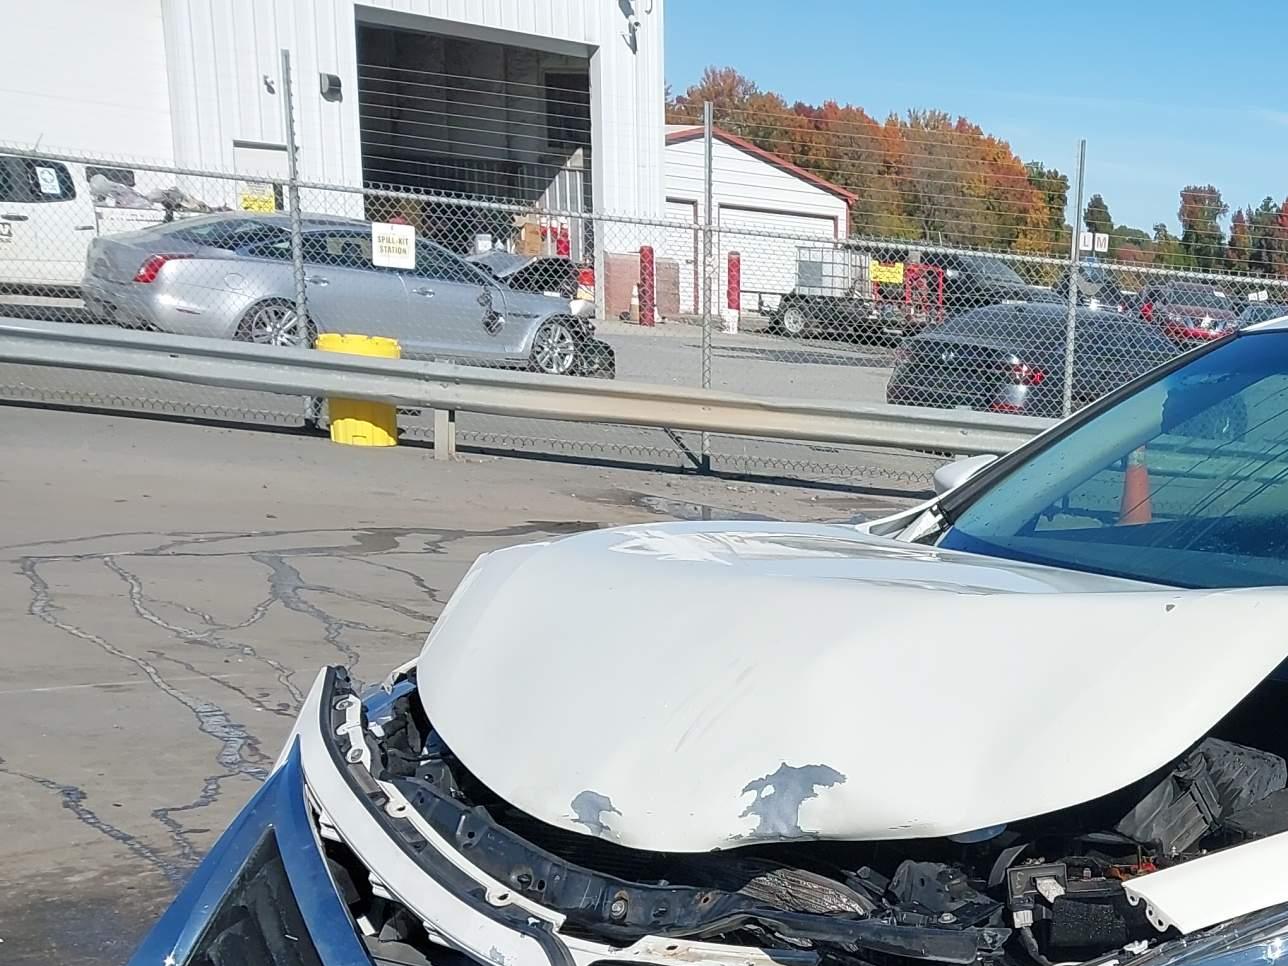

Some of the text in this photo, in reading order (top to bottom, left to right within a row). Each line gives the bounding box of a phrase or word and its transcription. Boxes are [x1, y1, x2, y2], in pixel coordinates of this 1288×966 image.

[1083, 235, 1089, 248] L
[1096, 236, 1107, 249] M
[379, 245, 407, 255] STATION
